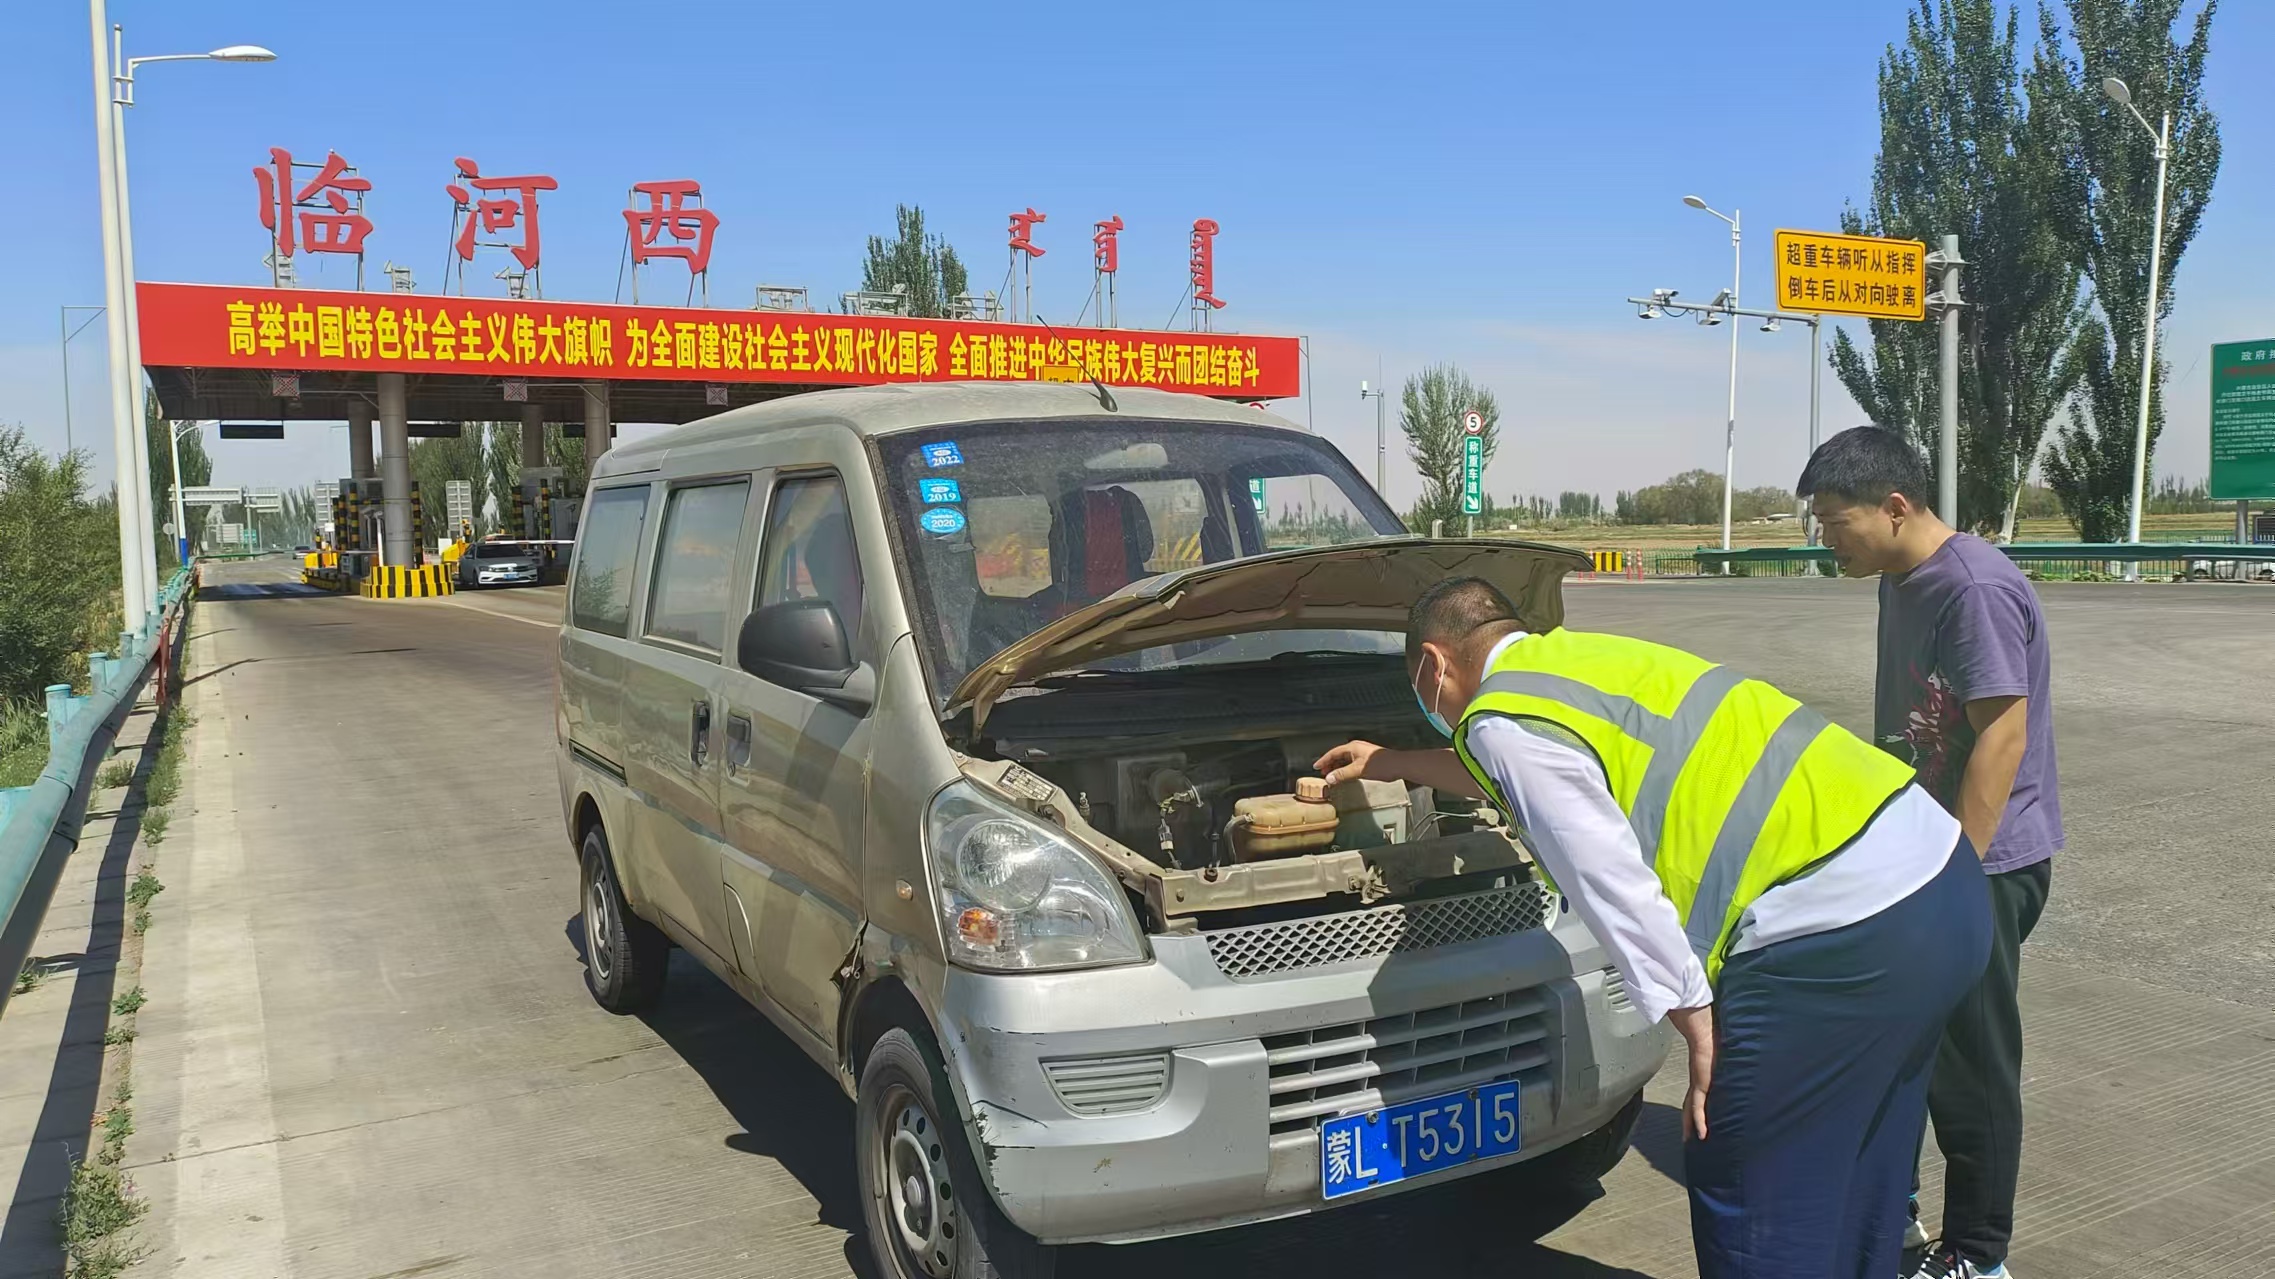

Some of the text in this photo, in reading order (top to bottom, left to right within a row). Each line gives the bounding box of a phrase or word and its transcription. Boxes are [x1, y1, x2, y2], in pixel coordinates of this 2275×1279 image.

[252, 146, 719, 274] 临河西
[1786, 241, 1916, 276] 超重车辆听从指挥
[1788, 275, 1916, 308] 倒车后从对向驶离
[226, 300, 614, 367] 高举中国特色社会主义伟大旗帜
[626, 318, 938, 375] 为全面建设社会主义现代化国家
[1470, 417, 1477, 428] 5
[932, 455, 960, 466] 2022
[1468, 441, 1479, 494] 称重车道
[928, 493, 956, 502] 2019
[931, 519, 955, 527] 2020
